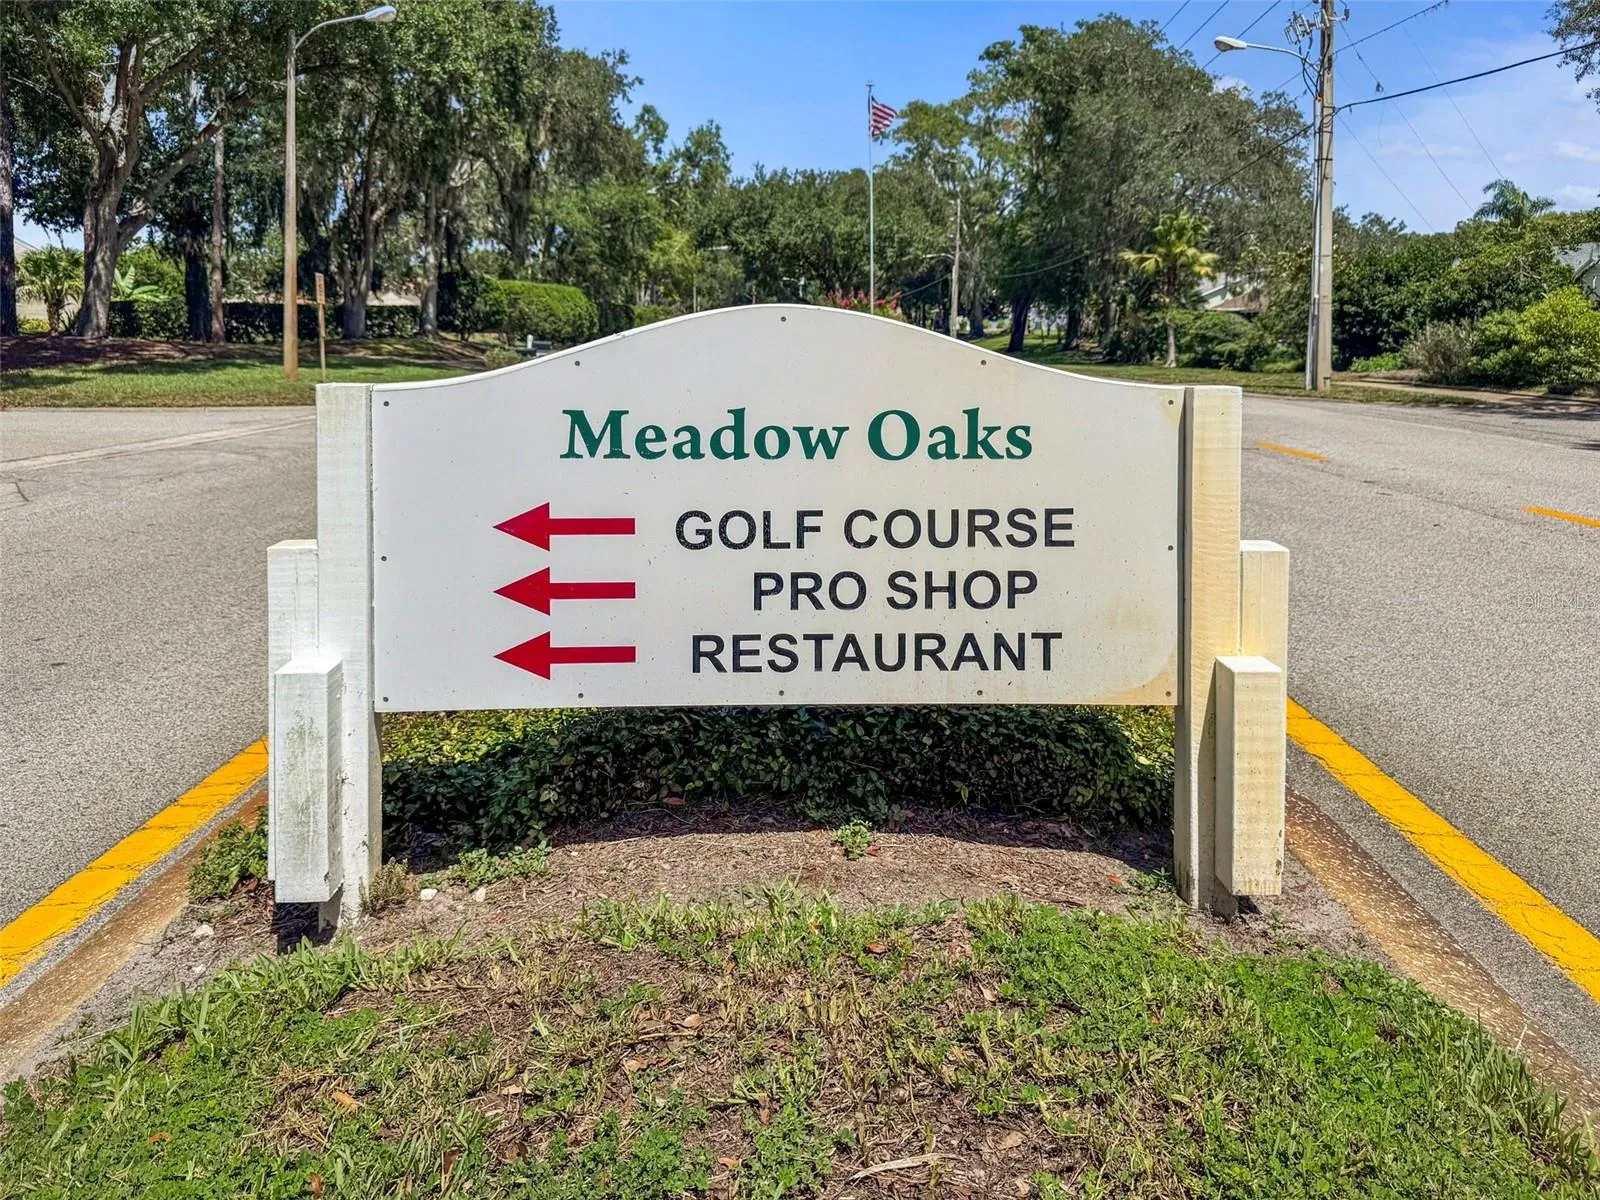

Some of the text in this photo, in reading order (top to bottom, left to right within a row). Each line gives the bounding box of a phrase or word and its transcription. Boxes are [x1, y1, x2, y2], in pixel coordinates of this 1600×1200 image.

[559, 407, 1034, 461] Meadow Oaks
[675, 507, 1075, 551] GOLF COURSE
[753, 569, 1038, 611] PRO SHOP
[692, 631, 1063, 674] RESTAURANT
